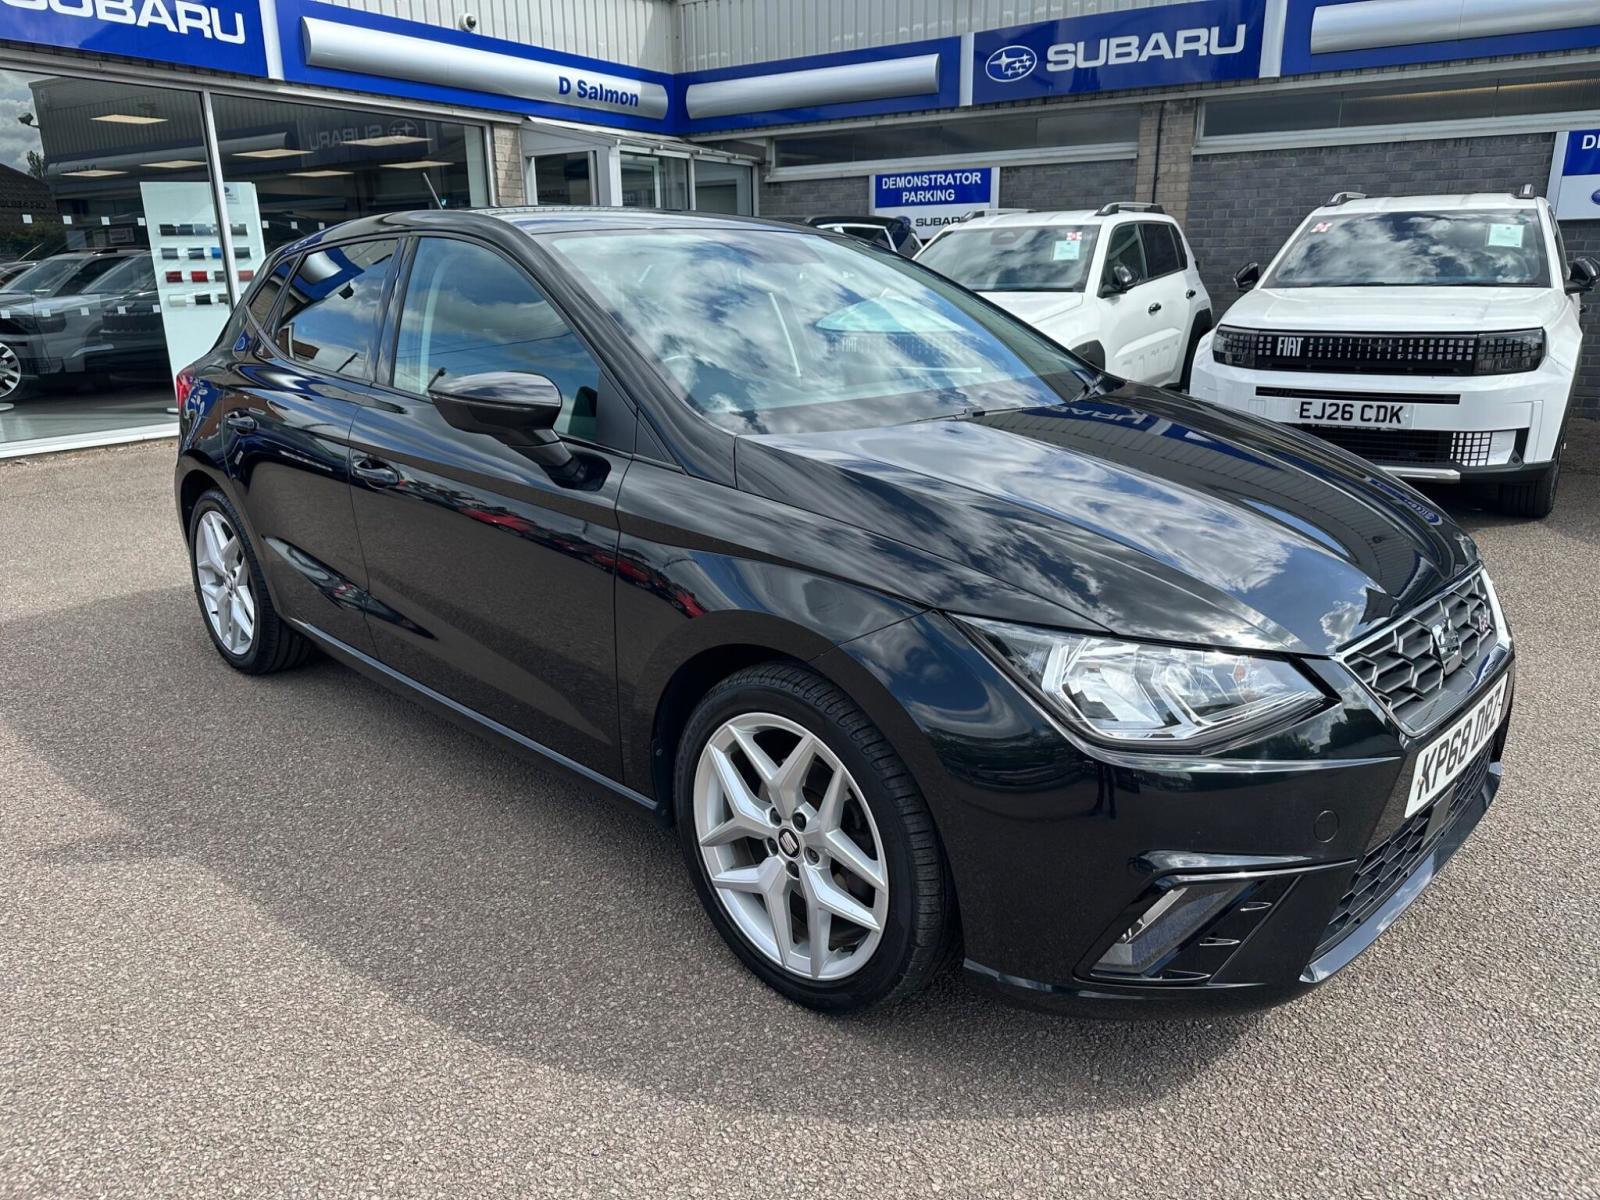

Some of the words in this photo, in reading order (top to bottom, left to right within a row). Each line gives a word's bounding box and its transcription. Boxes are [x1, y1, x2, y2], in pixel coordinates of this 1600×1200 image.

[1046, 23, 1247, 72] SUBARU
[558, 75, 572, 95] D
[576, 78, 639, 107] Salmon
[1581, 134, 1600, 150] D
[881, 171, 982, 189] DEMONSTRATOR
[902, 189, 956, 203] PARKING
[915, 215, 962, 227] SUBAR
[1276, 336, 1304, 357] FIAT
[1299, 401, 1354, 421] EJ26
[1360, 404, 1404, 424] CDK
[1417, 718, 1473, 801] KP68
[1470, 685, 1502, 752] DRZ
